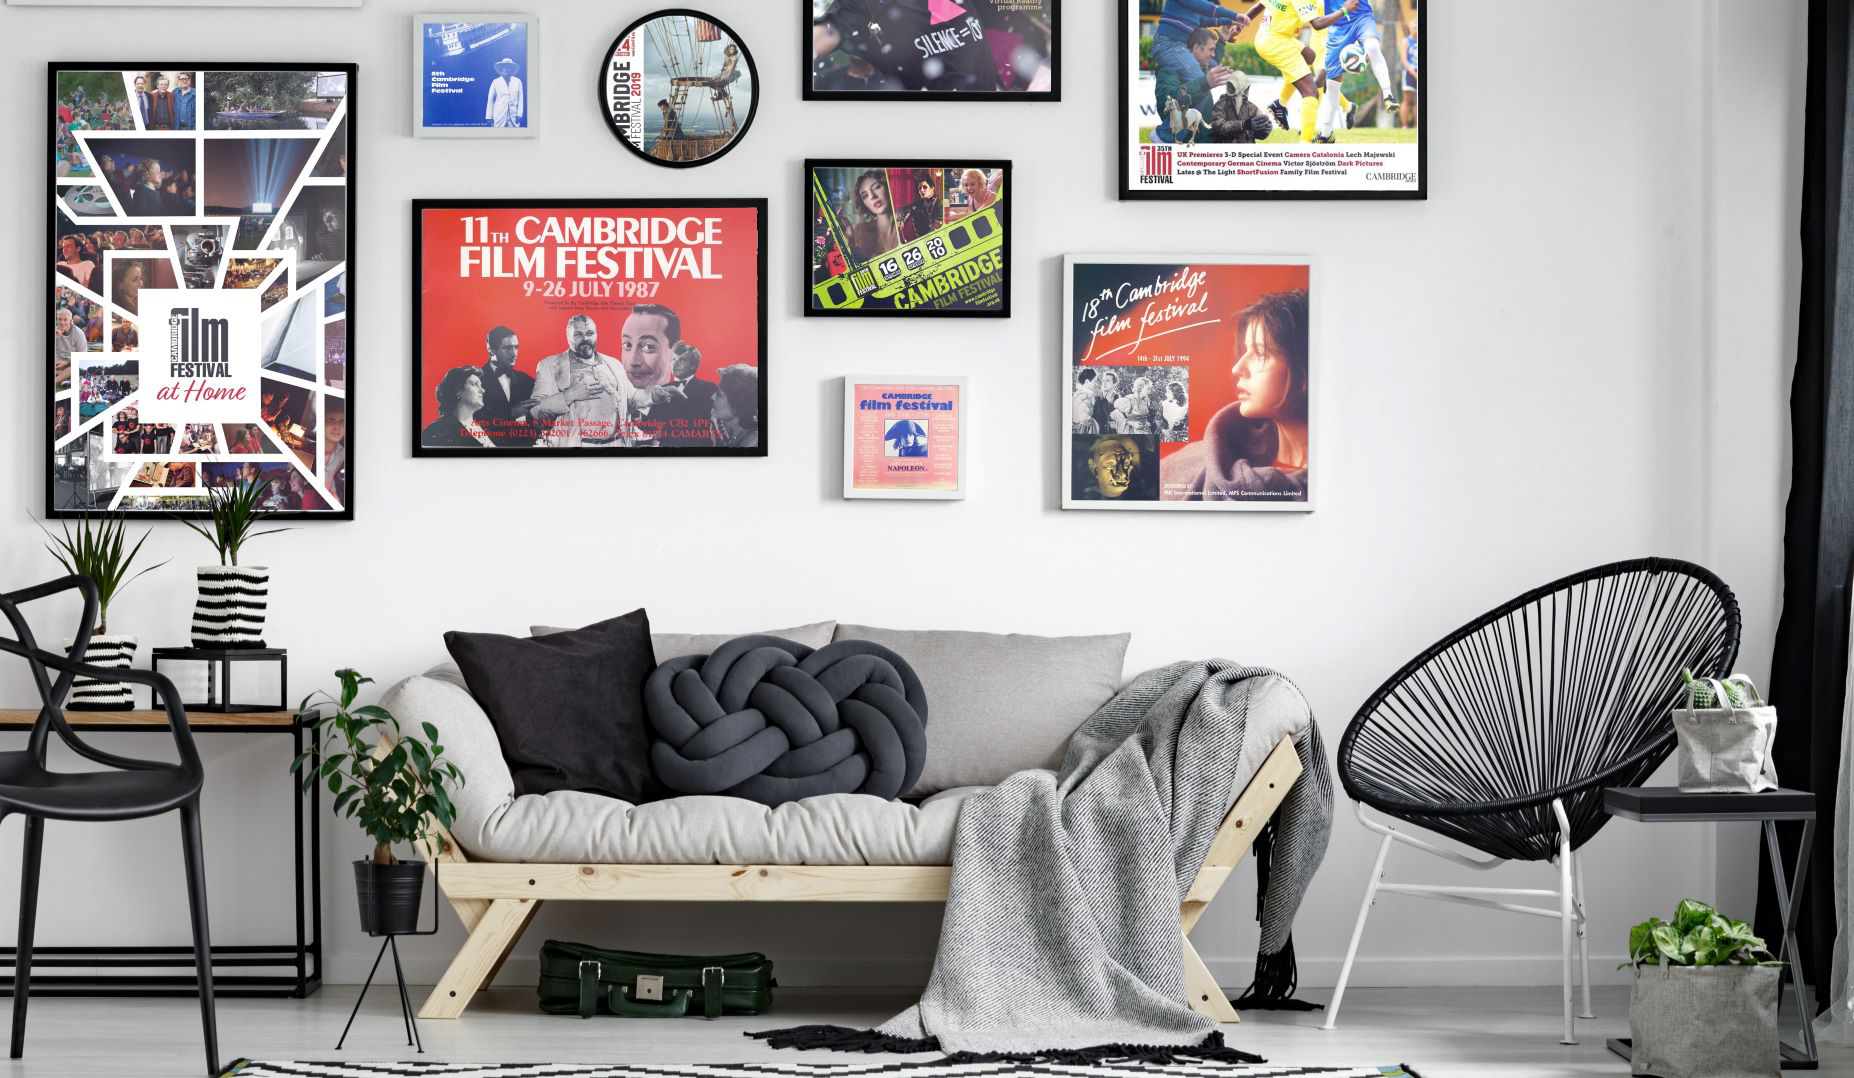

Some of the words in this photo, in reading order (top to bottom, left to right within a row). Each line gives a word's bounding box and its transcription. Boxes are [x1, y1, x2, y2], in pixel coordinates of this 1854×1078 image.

[997, 4, 1043, 12] programme
[630, 72, 642, 97] 2019
[630, 98, 642, 139] FESTIVAL
[1177, 160, 1226, 168] Contemporary
[1305, 160, 1336, 168] Sjöström
[1238, 151, 1262, 159] Special
[1363, 151, 1396, 159] Majewski
[1140, 176, 1174, 184] FESTIVAL
[1217, 169, 1236, 177] Light
[1280, 169, 1303, 177] Family
[1365, 173, 1417, 181] CAMBRIDGE
[514, 215, 723, 245] CAMBRIDGE
[927, 237, 943, 251] 20
[931, 246, 946, 259] 10
[459, 246, 545, 278] FILM
[556, 246, 723, 280] FESTIVAL
[902, 248, 923, 266] 26
[879, 258, 899, 276] 16
[893, 247, 1003, 310] CAMBRIDGE
[958, 273, 1003, 302] FESTIVAL
[522, 280, 566, 298] 9-26
[569, 281, 613, 298] JULY
[615, 281, 660, 298] 1987
[1081, 288, 1114, 322] 18th
[1115, 266, 1207, 309] Cambridge
[169, 307, 229, 362] film
[1081, 315, 1131, 361] film
[1127, 291, 1209, 355] festival
[170, 313, 179, 362] CAMBRIDGE
[170, 362, 233, 378] FESTIVAL
[156, 381, 181, 401] at
[183, 379, 247, 403] Home
[860, 400, 892, 410] film
[895, 400, 953, 411] festival
